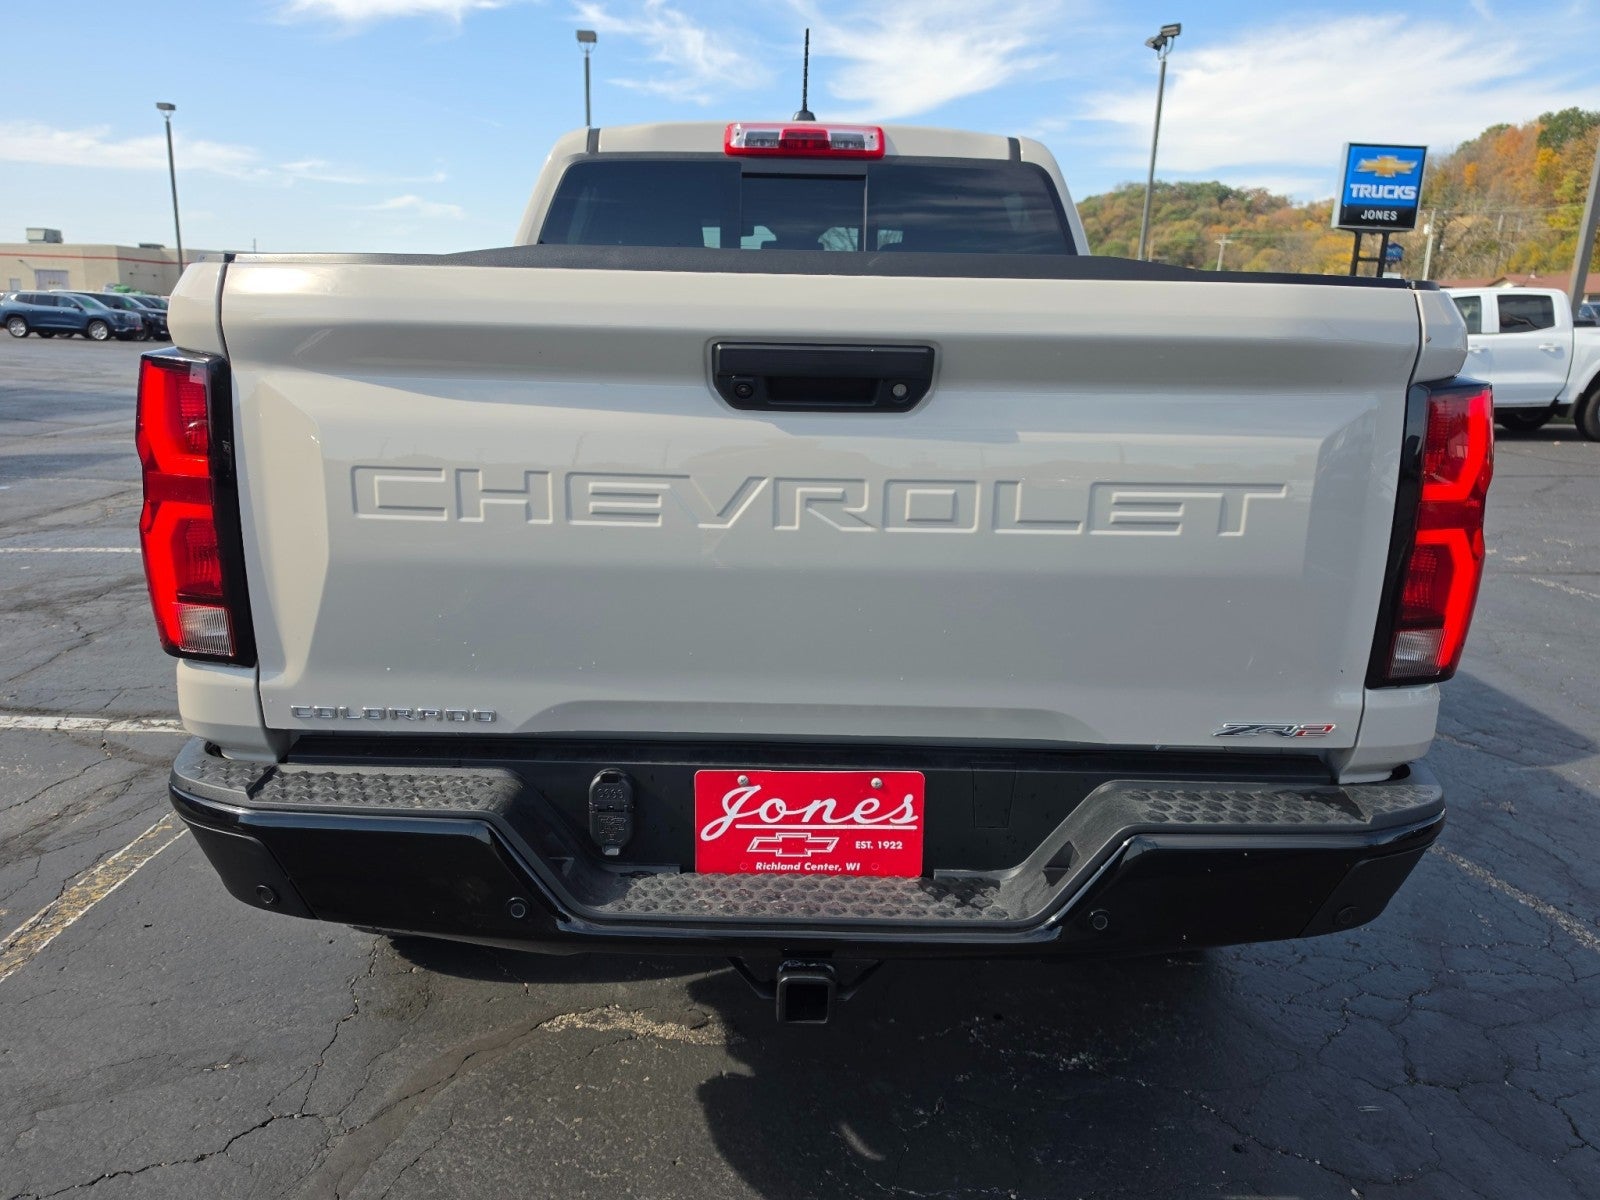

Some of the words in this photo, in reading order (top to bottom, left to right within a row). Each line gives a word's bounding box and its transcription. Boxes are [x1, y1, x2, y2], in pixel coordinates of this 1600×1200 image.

[1350, 183, 1417, 200] TRUCKS
[1360, 209, 1398, 221] JONES
[350, 465, 1288, 537] CHEVROLET
[290, 705, 497, 724] COLORADO
[1212, 722, 1336, 738] ZR2
[700, 784, 919, 842] Jones
[855, 840, 874, 850] EST.
[877, 840, 903, 850] 1922
[755, 861, 801, 872] Richland
[804, 862, 842, 872] Center,
[846, 862, 861, 872] WI
